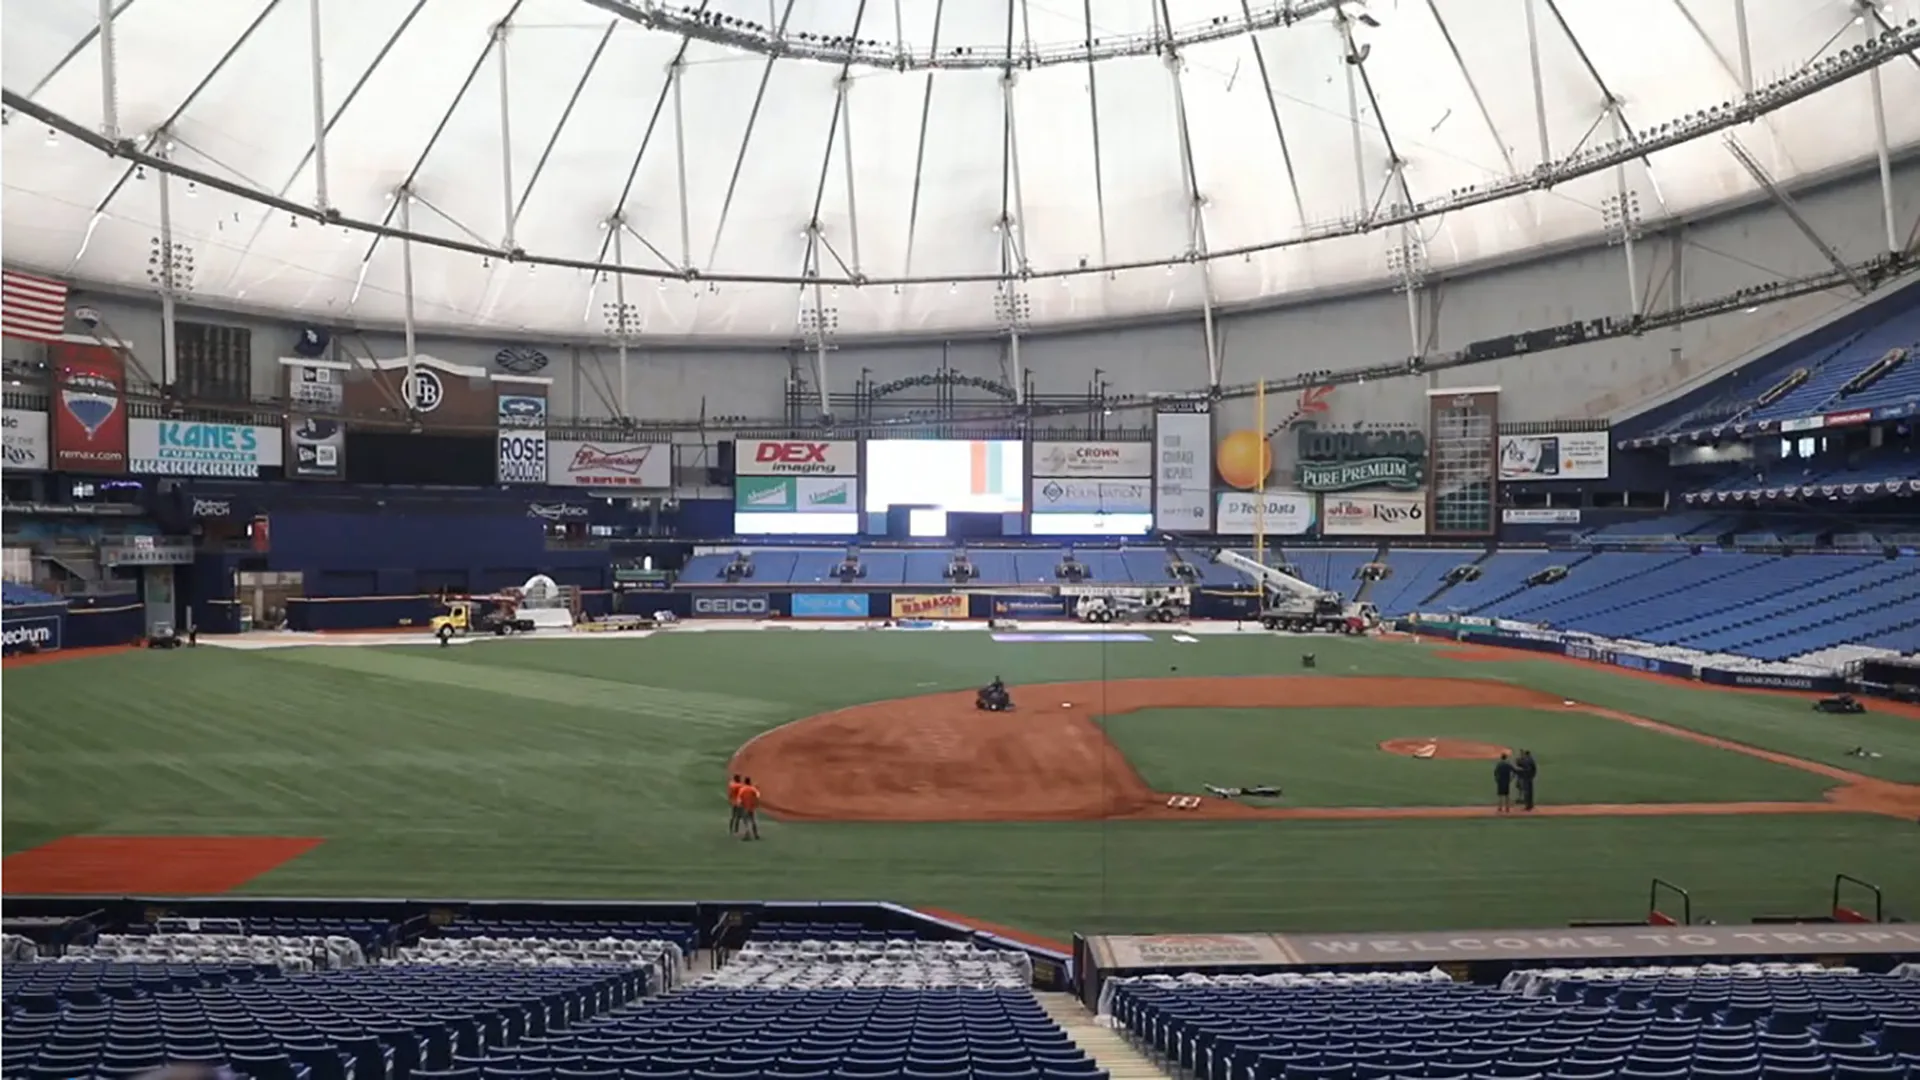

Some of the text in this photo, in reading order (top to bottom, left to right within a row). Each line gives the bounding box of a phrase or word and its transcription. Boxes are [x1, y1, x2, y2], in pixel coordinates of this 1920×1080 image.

[159, 422, 257, 450] KANE'S
[60, 450, 122, 460] remax.com
[500, 438, 544, 461] ROSE
[755, 442, 830, 463] DEX
[1077, 448, 1119, 457] CROWN
[500, 461, 544, 481] RADIOLOGY
[772, 462, 836, 473] imaging
[1303, 463, 1406, 486] PURE PREMIUM
[1268, 503, 1296, 515] Data
[1409, 503, 1422, 519] 6
[696, 599, 765, 613] GEICO
[1310, 935, 1625, 954] WELCOME
[1635, 933, 1718, 947] TO
